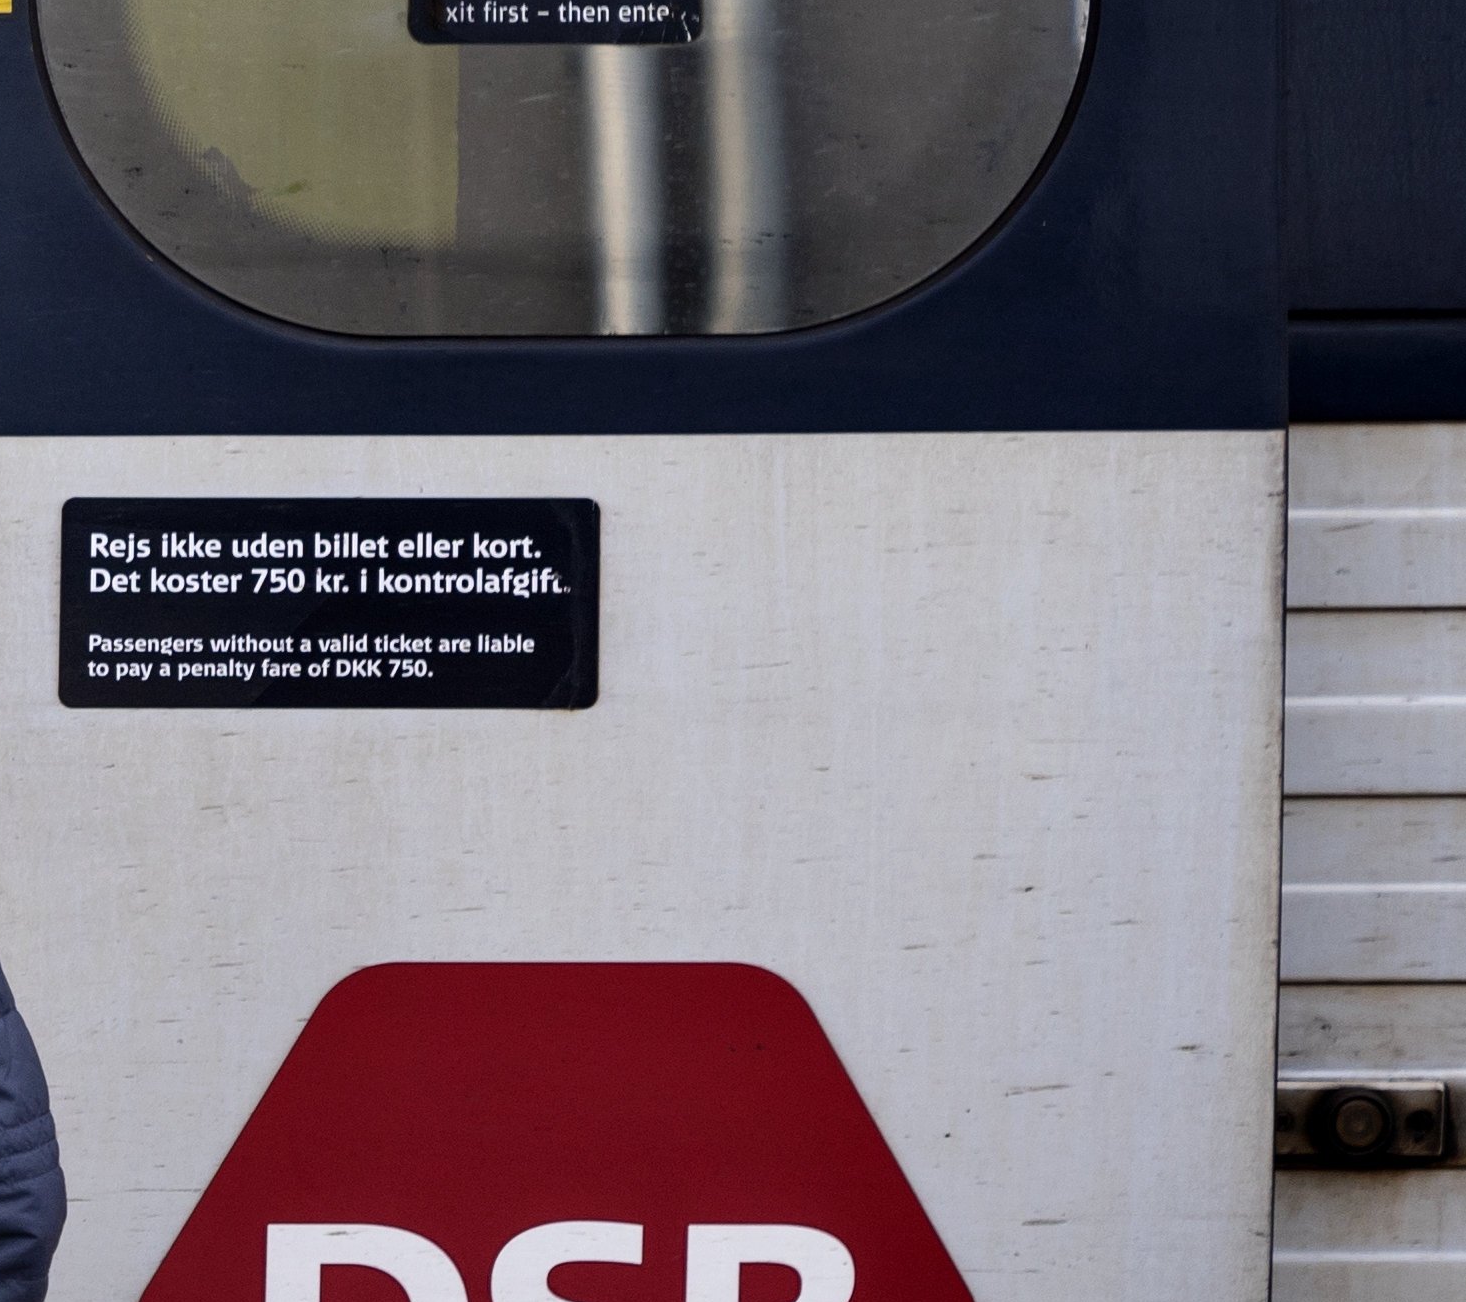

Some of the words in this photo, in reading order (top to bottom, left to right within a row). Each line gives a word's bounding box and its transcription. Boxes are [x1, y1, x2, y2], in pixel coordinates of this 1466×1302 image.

[447, 1, 474, 22] xit
[484, 1, 528, 22] first
[559, 1, 609, 22] then
[619, 3, 669, 22] ente
[91, 533, 150, 563] Rejs
[162, 532, 221, 557] ikke
[232, 533, 303, 558] uden
[315, 533, 388, 558] billet
[398, 533, 464, 558] eller
[474, 533, 541, 558] kort.
[90, 568, 140, 592] Det
[151, 567, 242, 593] koster
[251, 568, 305, 593] 750
[316, 567, 349, 593] kr.
[361, 568, 367, 592] i
[379, 567, 570, 598] kontrolafgift.
[89, 635, 203, 655] Passengers
[210, 634, 293, 652] without
[300, 639, 311, 652] a
[319, 634, 367, 652] valid
[374, 634, 432, 652] ticket
[439, 639, 471, 652] are
[478, 634, 534, 652] liable
[88, 661, 109, 676] to
[116, 663, 152, 680] pay
[160, 663, 170, 676] a
[178, 659, 255, 681] penalty
[262, 659, 301, 677] fare
[308, 659, 330, 677] of
[336, 659, 381, 677] DKK
[389, 659, 433, 677] 750.
